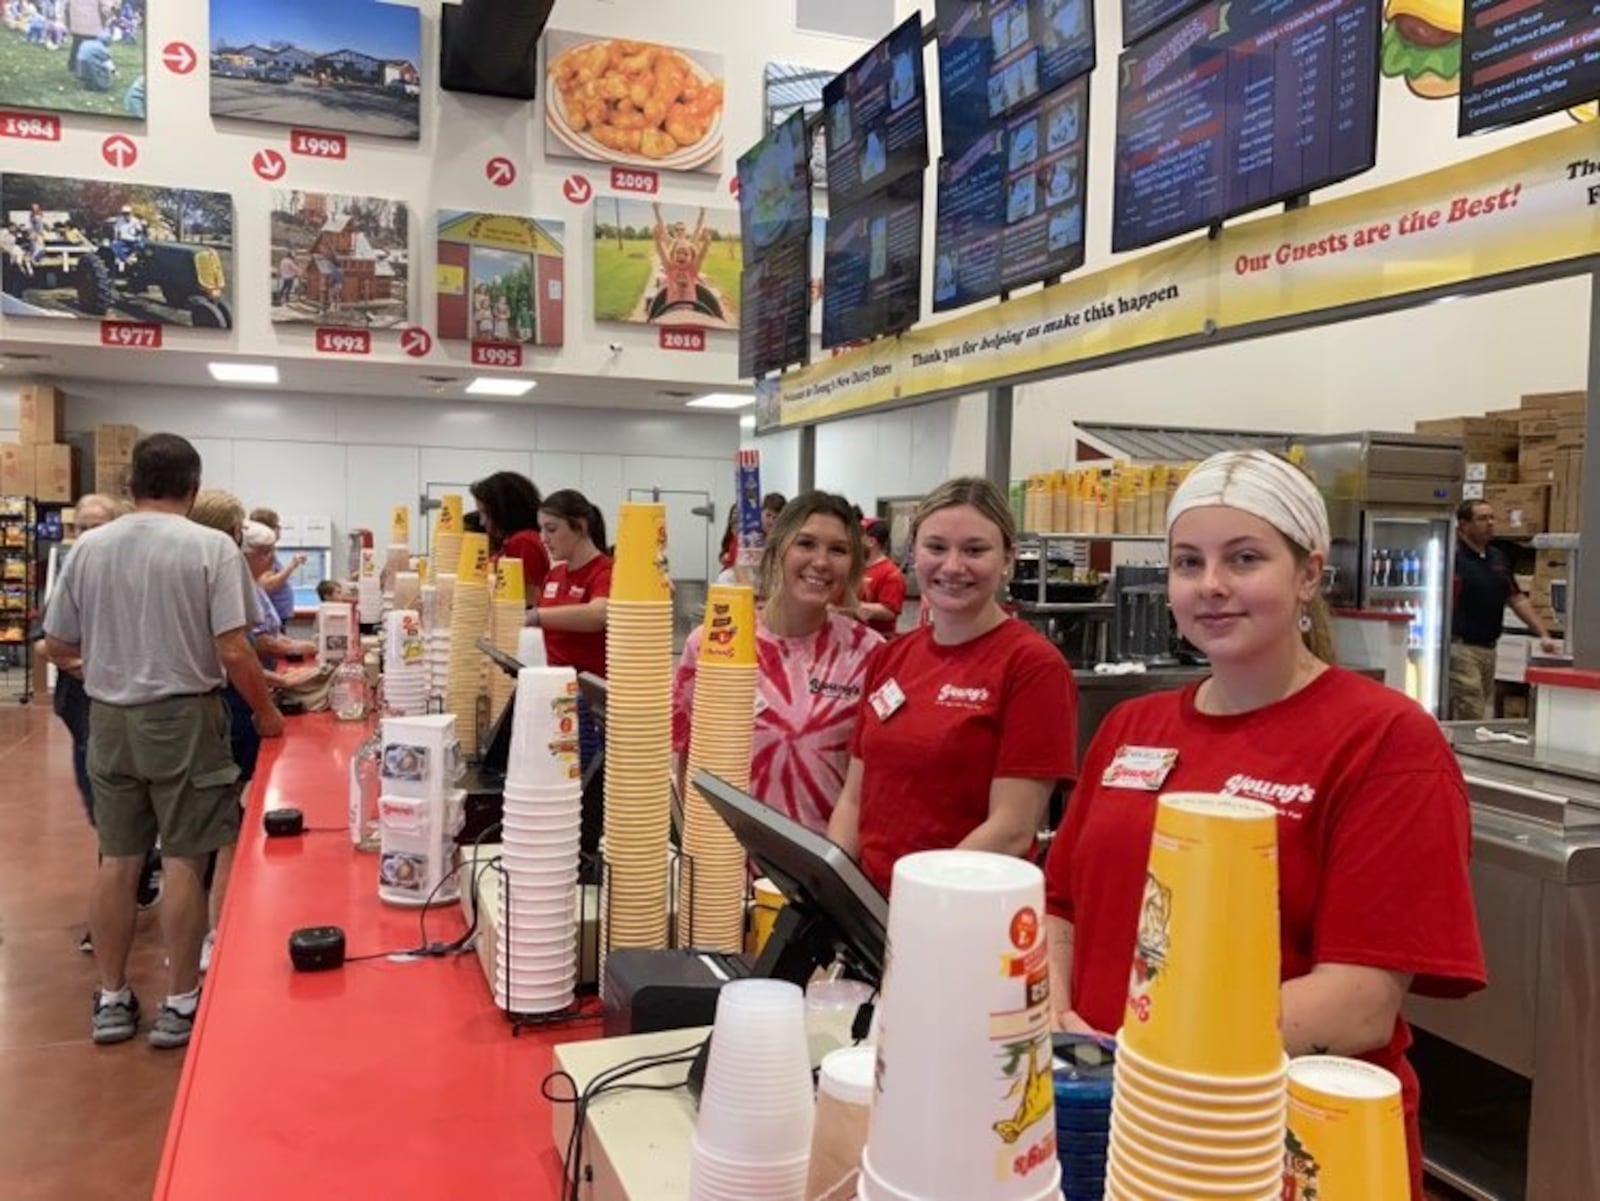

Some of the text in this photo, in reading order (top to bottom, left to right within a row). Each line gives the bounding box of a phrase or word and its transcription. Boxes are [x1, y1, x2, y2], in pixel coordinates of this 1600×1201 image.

[5, 118, 55, 139] 1984
[296, 135, 341, 156] 1990
[615, 173, 653, 191] 2009
[1234, 183, 1523, 275] Our Guests are the Best!
[107, 324, 155, 346] 1977
[911, 284, 1179, 368] Thank you for helping us make this happen
[322, 333, 366, 353] 1992
[664, 332, 702, 349] 2010
[477, 348, 517, 365] 1995
[1219, 773, 1316, 804] Young's
